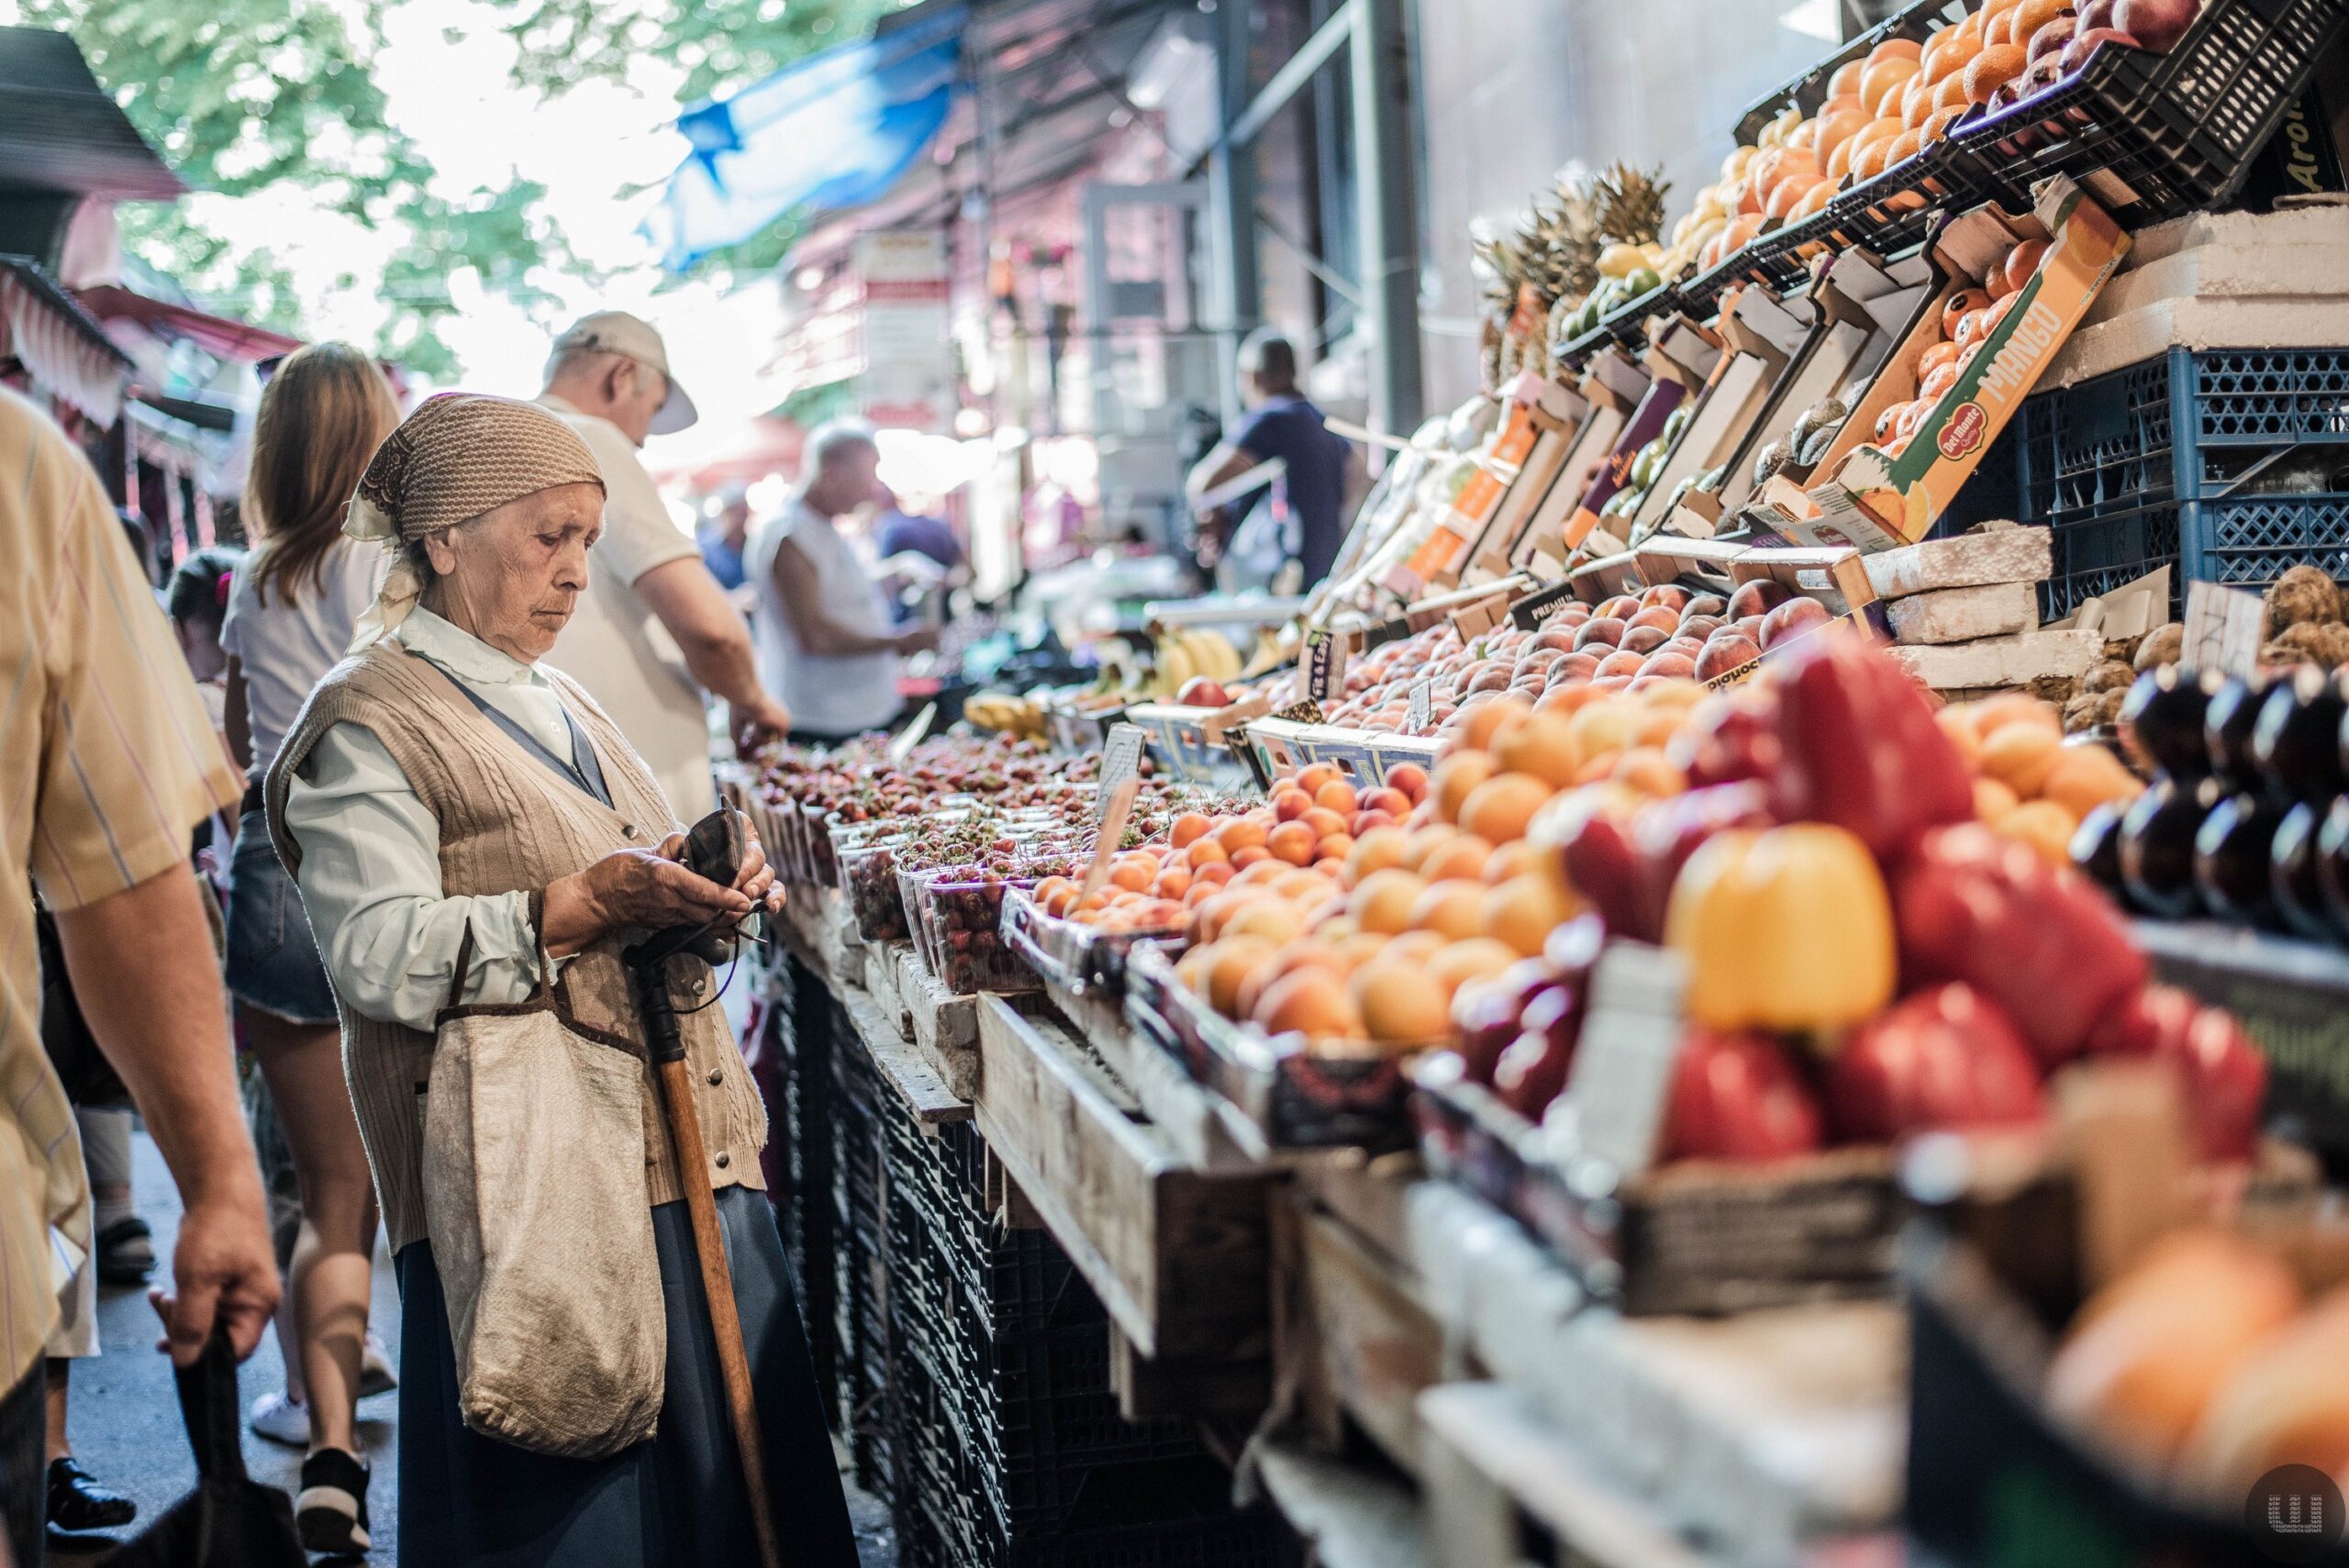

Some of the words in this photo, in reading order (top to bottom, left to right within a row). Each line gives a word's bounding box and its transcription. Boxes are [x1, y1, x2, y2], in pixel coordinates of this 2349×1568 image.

[1976, 299, 2062, 404] MANGO
[1942, 434, 1961, 454] Del
[1954, 406, 1981, 439] Monte
